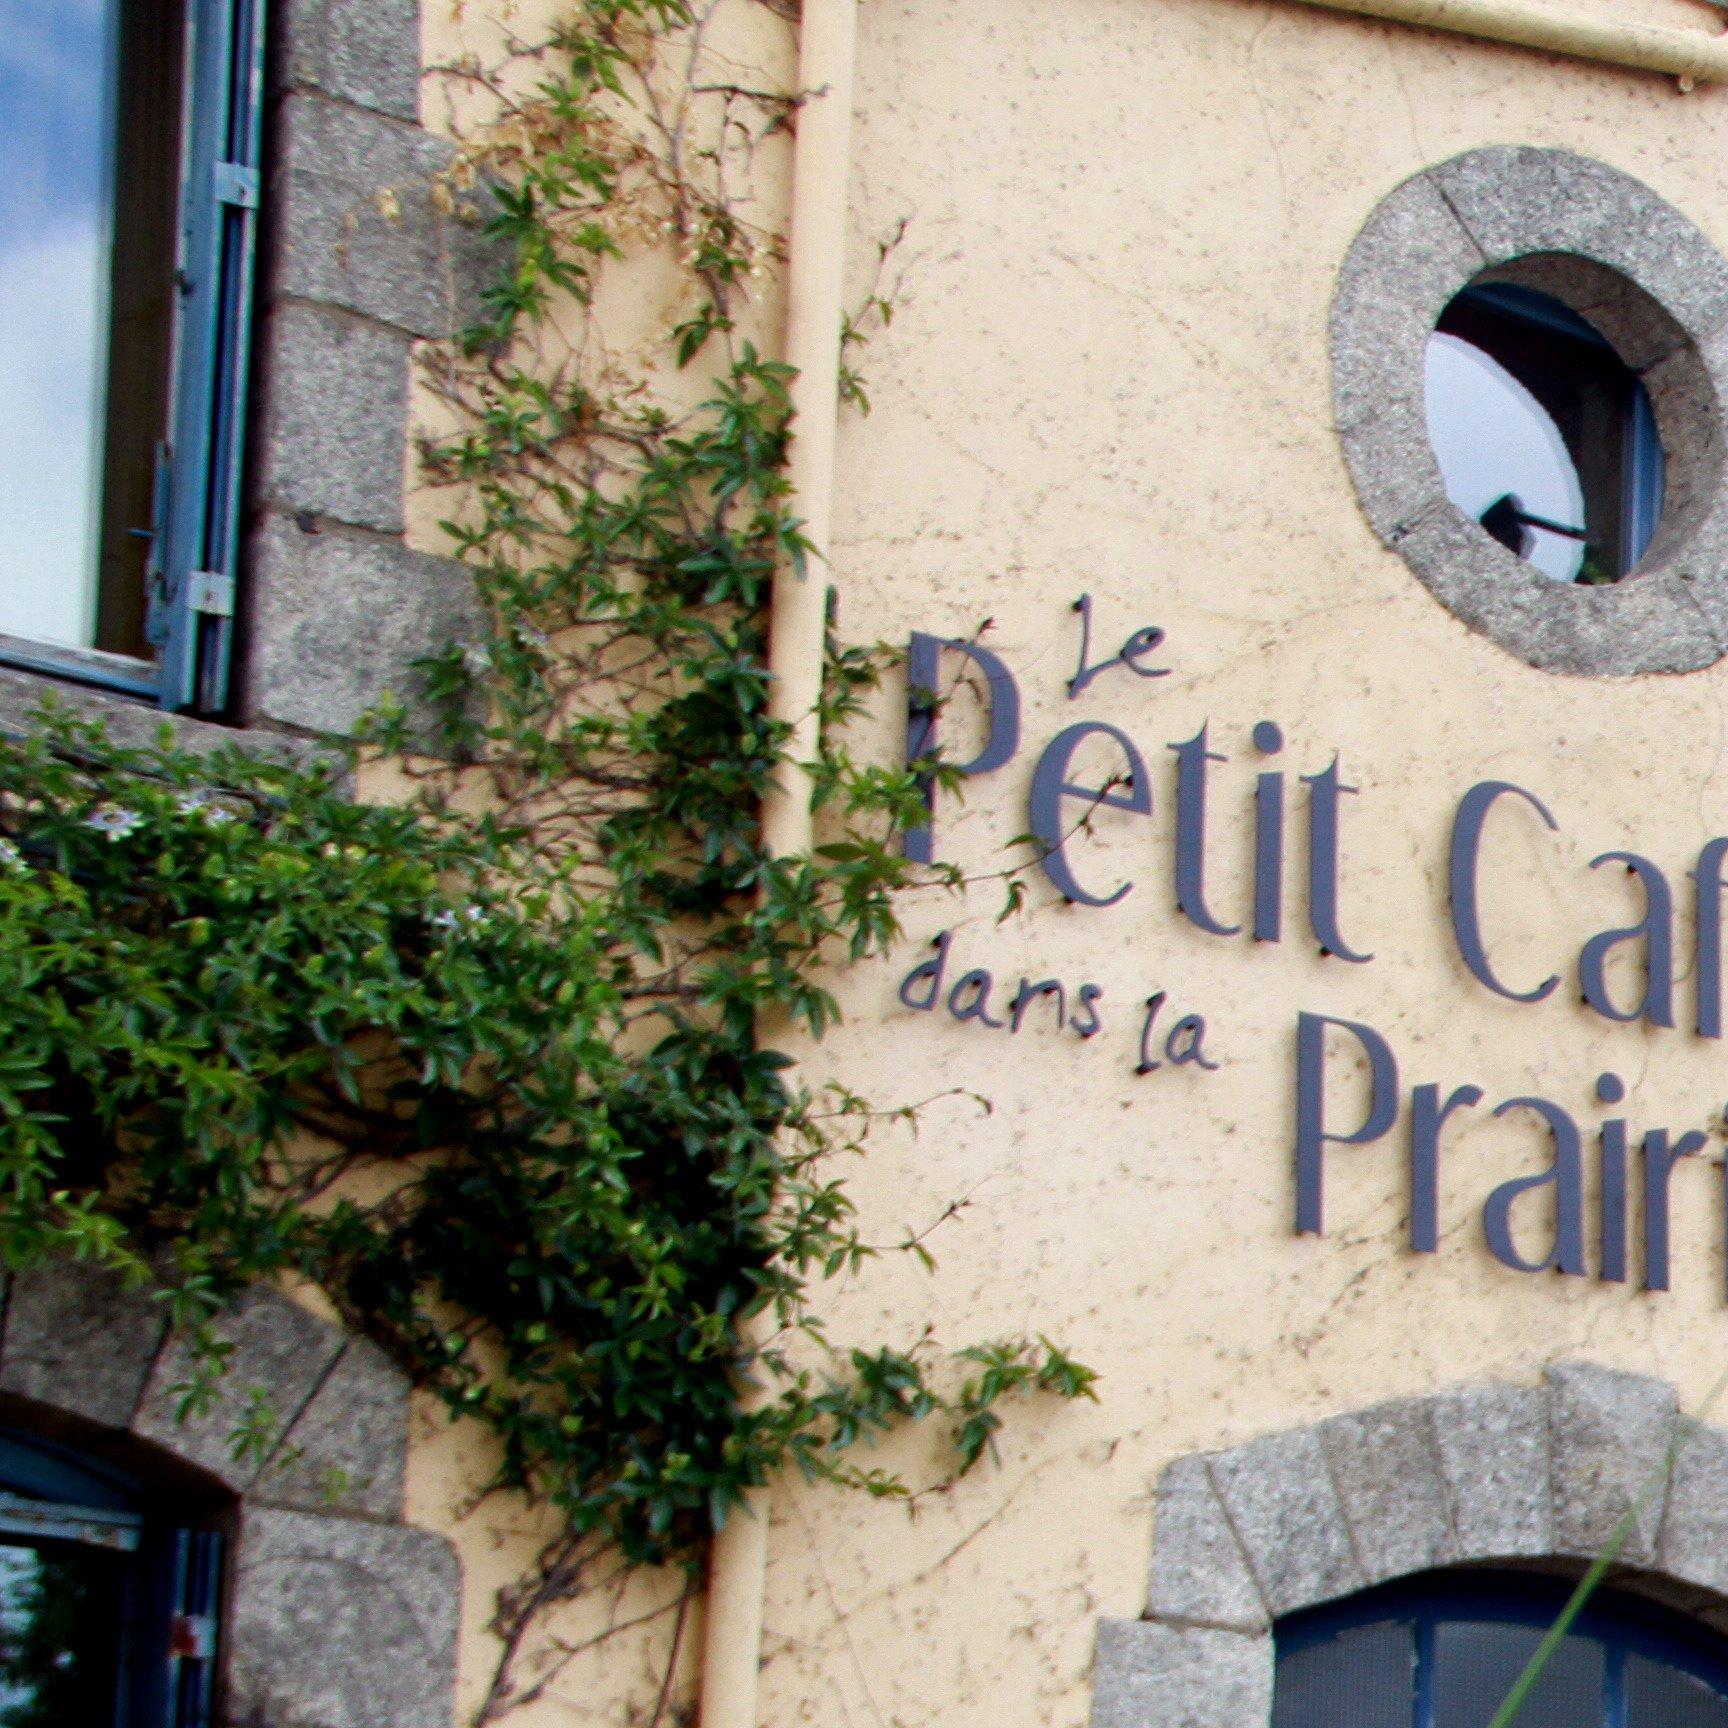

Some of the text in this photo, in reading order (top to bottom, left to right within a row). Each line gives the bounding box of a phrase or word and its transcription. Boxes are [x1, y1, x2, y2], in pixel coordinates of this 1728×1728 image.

[1067, 592, 1173, 699] Le
[902, 629, 1375, 964] Petit
[898, 929, 1220, 1075] dans la
